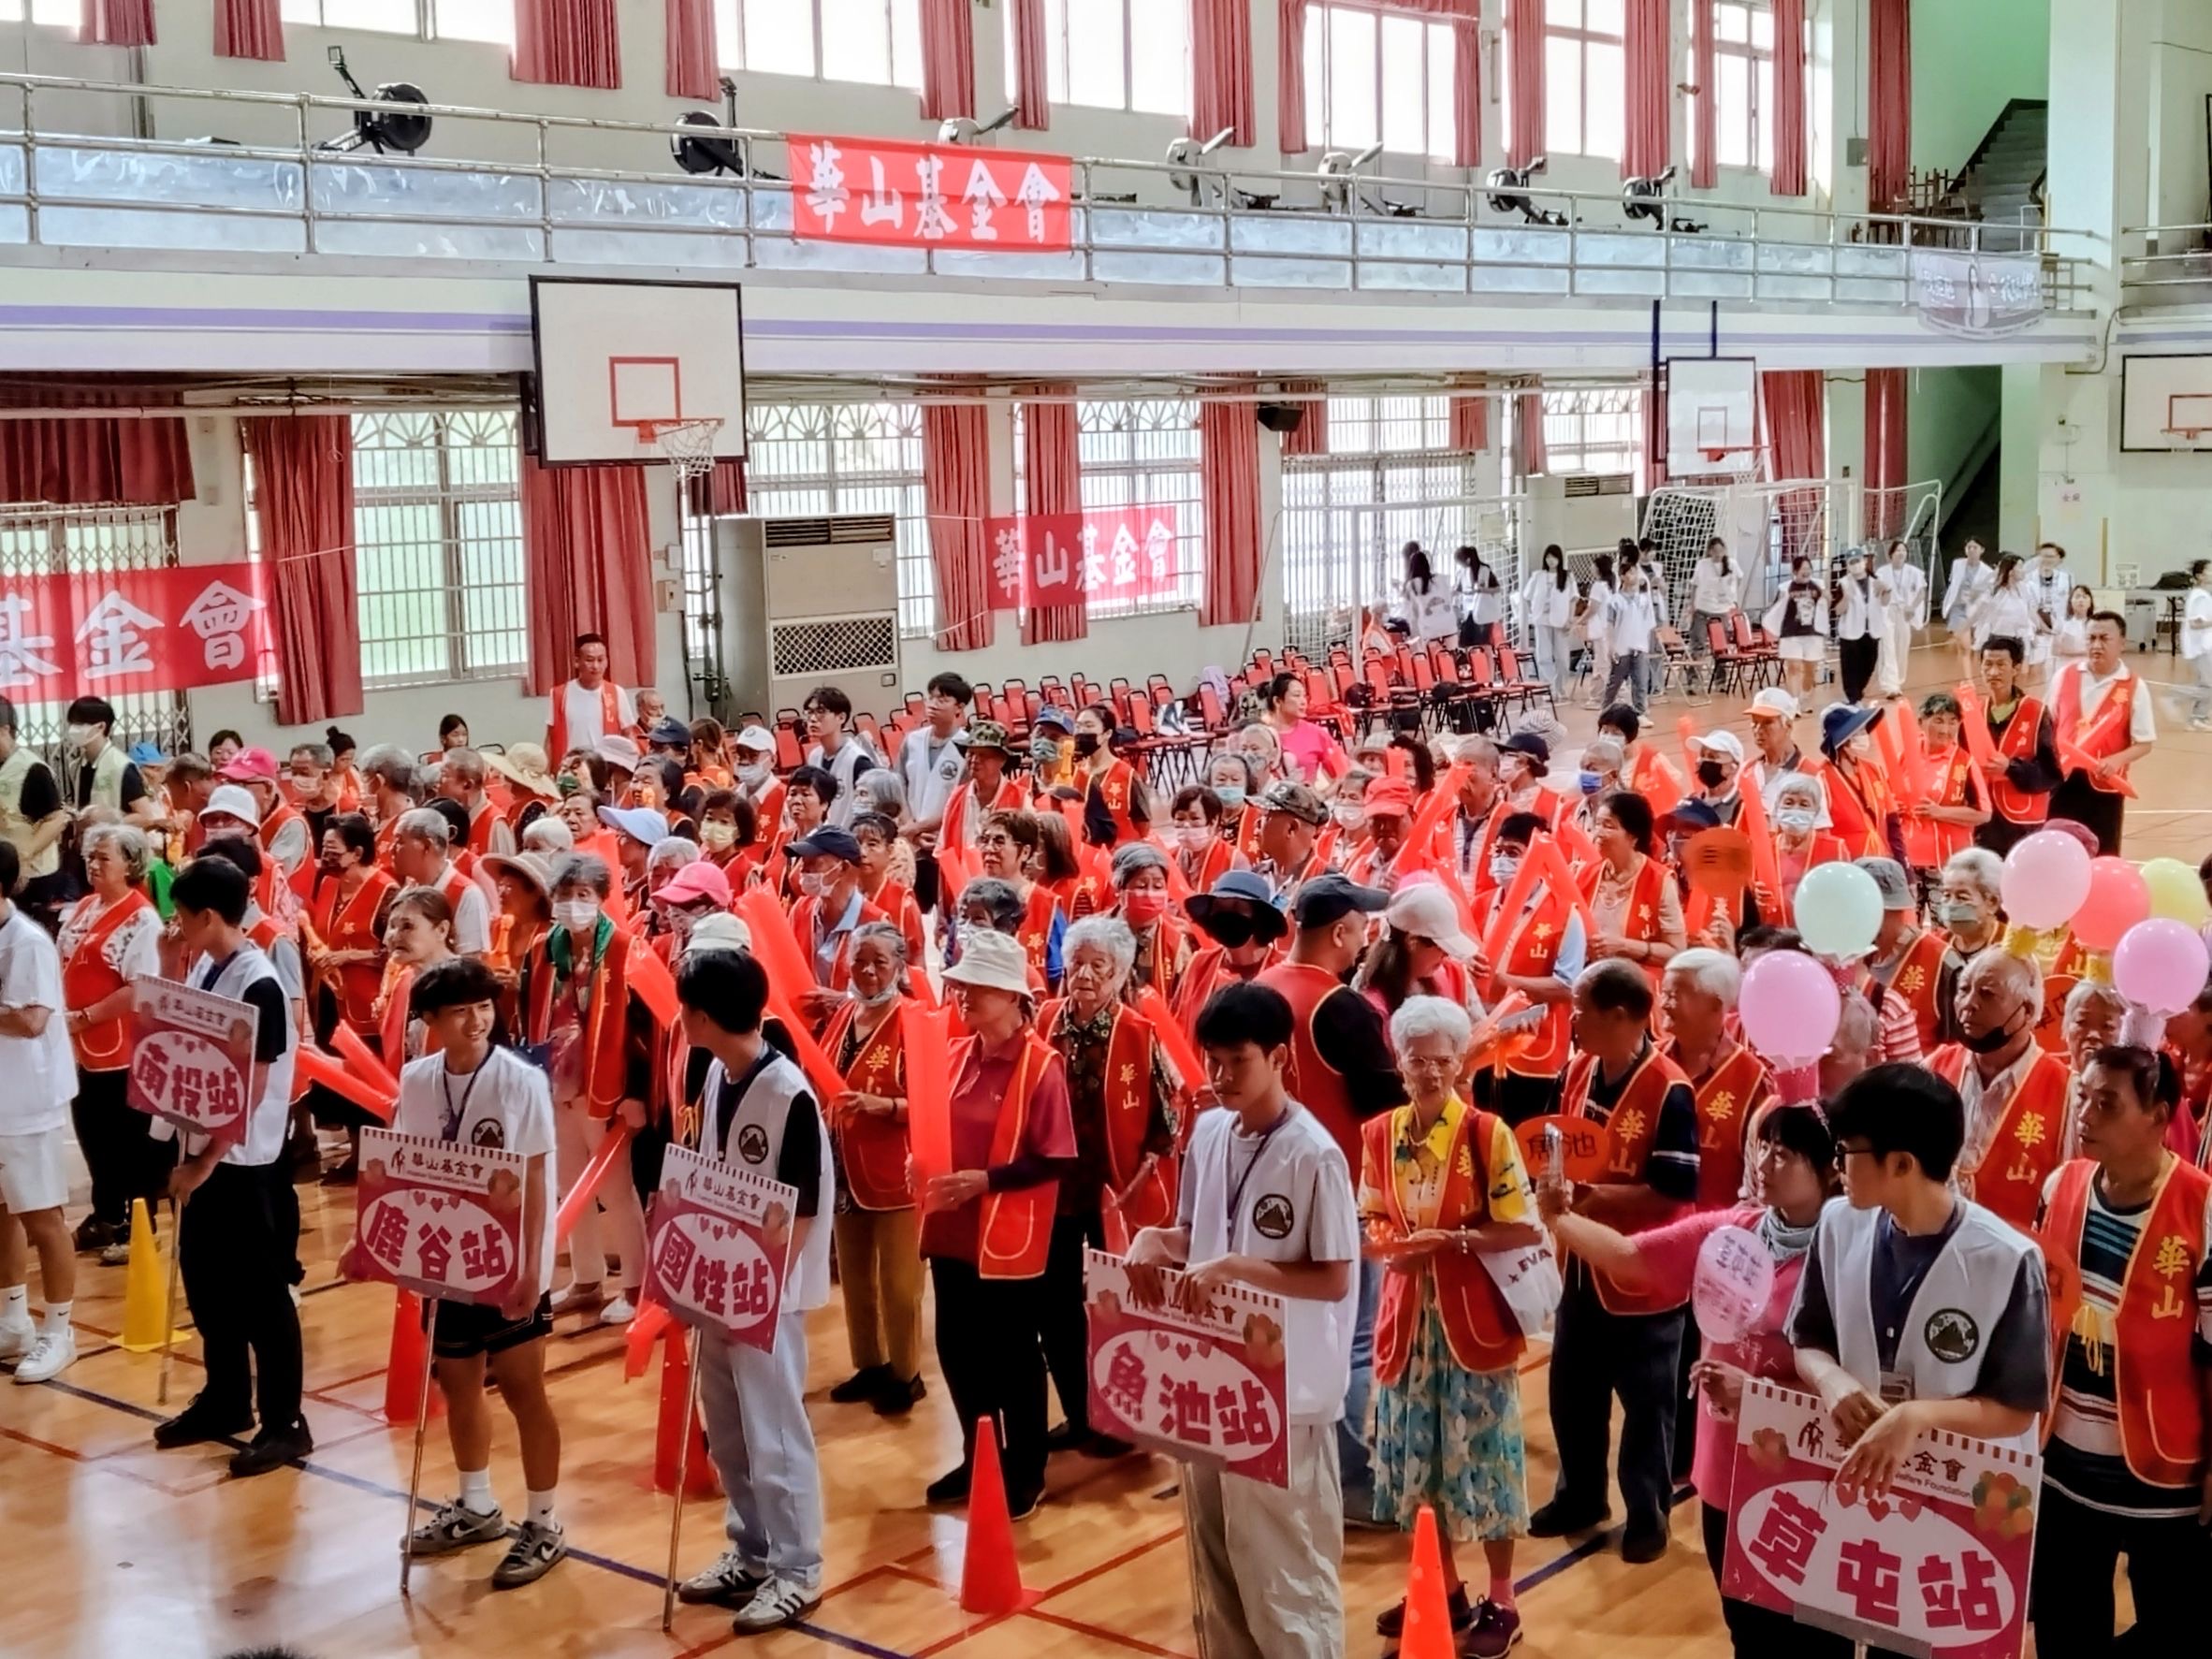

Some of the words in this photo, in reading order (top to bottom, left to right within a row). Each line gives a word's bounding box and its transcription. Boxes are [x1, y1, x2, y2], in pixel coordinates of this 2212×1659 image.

[806, 140, 1060, 243] 華山基金會
[993, 518, 1173, 599] 華山基金會
[1119, 1063, 1141, 1110] 華山
[1700, 1090, 1736, 1150] 華山
[1615, 1107, 1646, 1177] 華山
[2004, 1111, 2046, 1186] 華山
[366, 1200, 507, 1282] 鹿谷站
[656, 1220, 769, 1317] 國姓站
[2149, 1234, 2188, 1319] 華山
[1100, 1341, 1274, 1447] 魚池站
[1748, 1489, 2002, 1631] 草屯站
